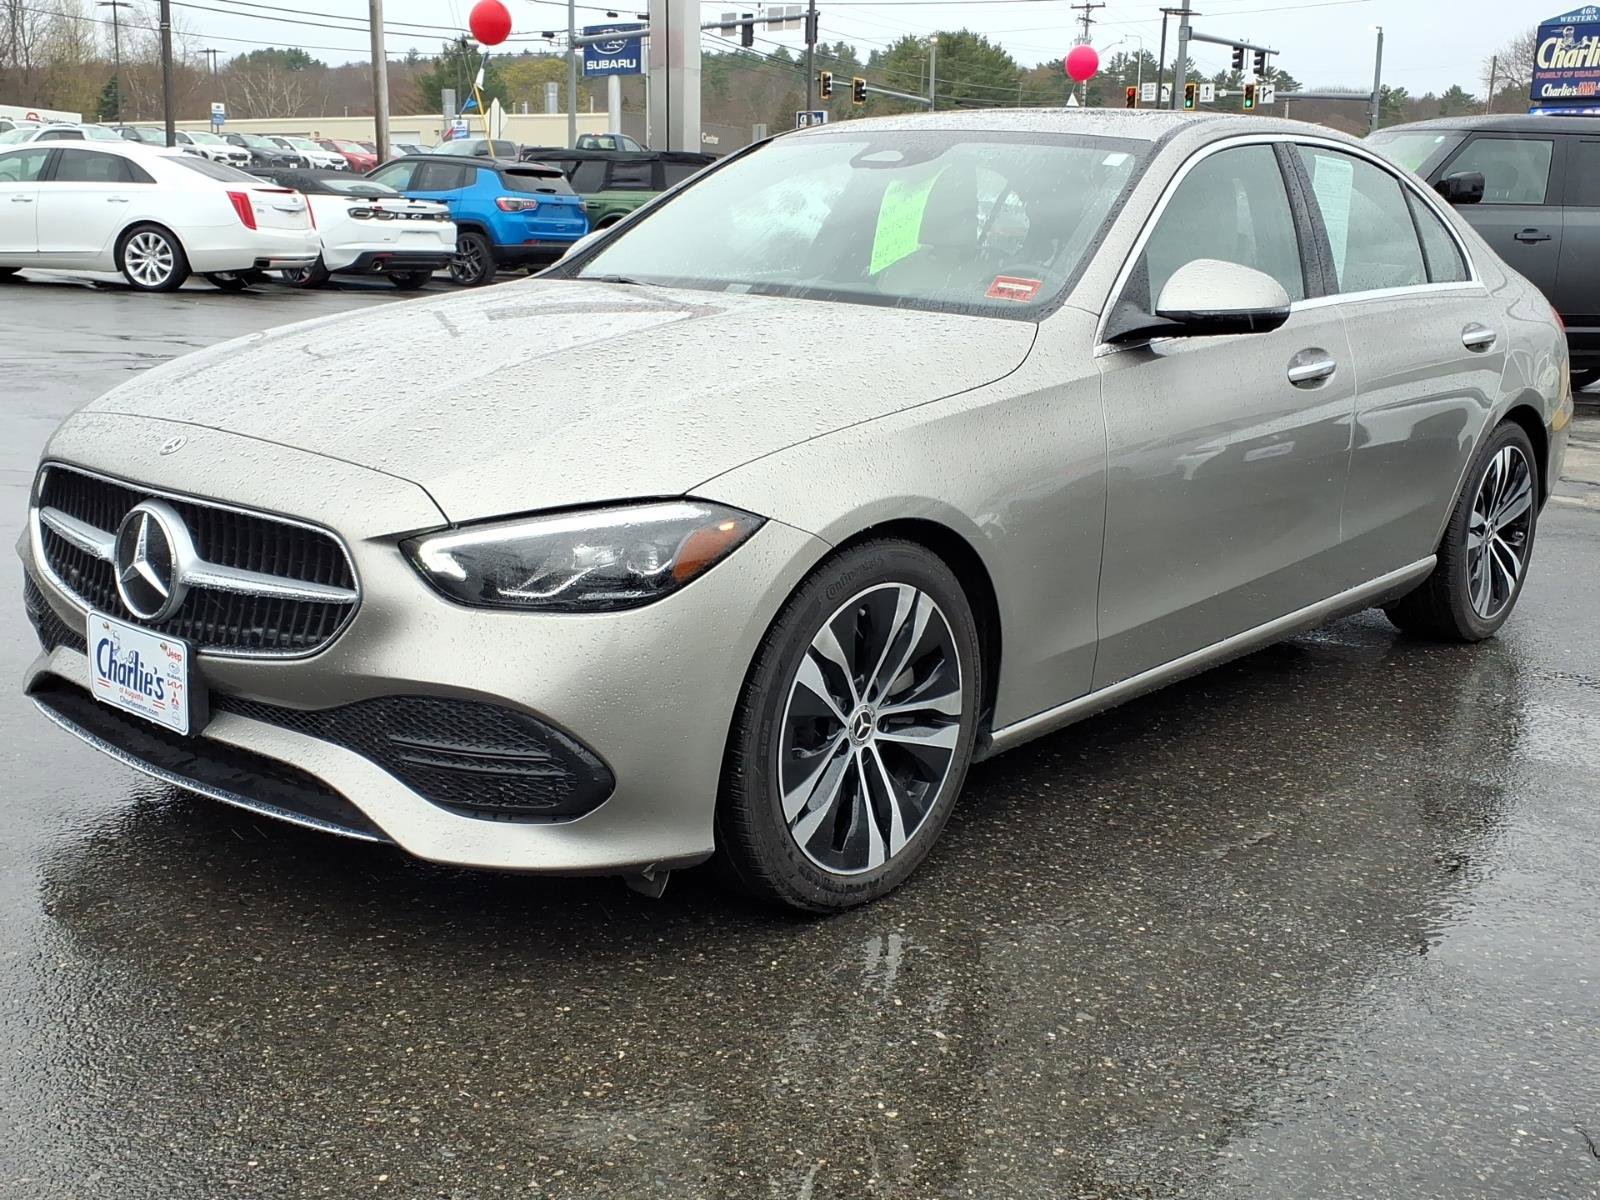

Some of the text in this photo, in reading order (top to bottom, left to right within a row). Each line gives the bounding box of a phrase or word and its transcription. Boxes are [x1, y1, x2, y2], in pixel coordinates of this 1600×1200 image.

[586, 58, 636, 70] SUBARU
[1541, 83, 1577, 97] Charlie's
[167, 648, 182, 663] Jeep
[97, 638, 164, 700] Charlie's
